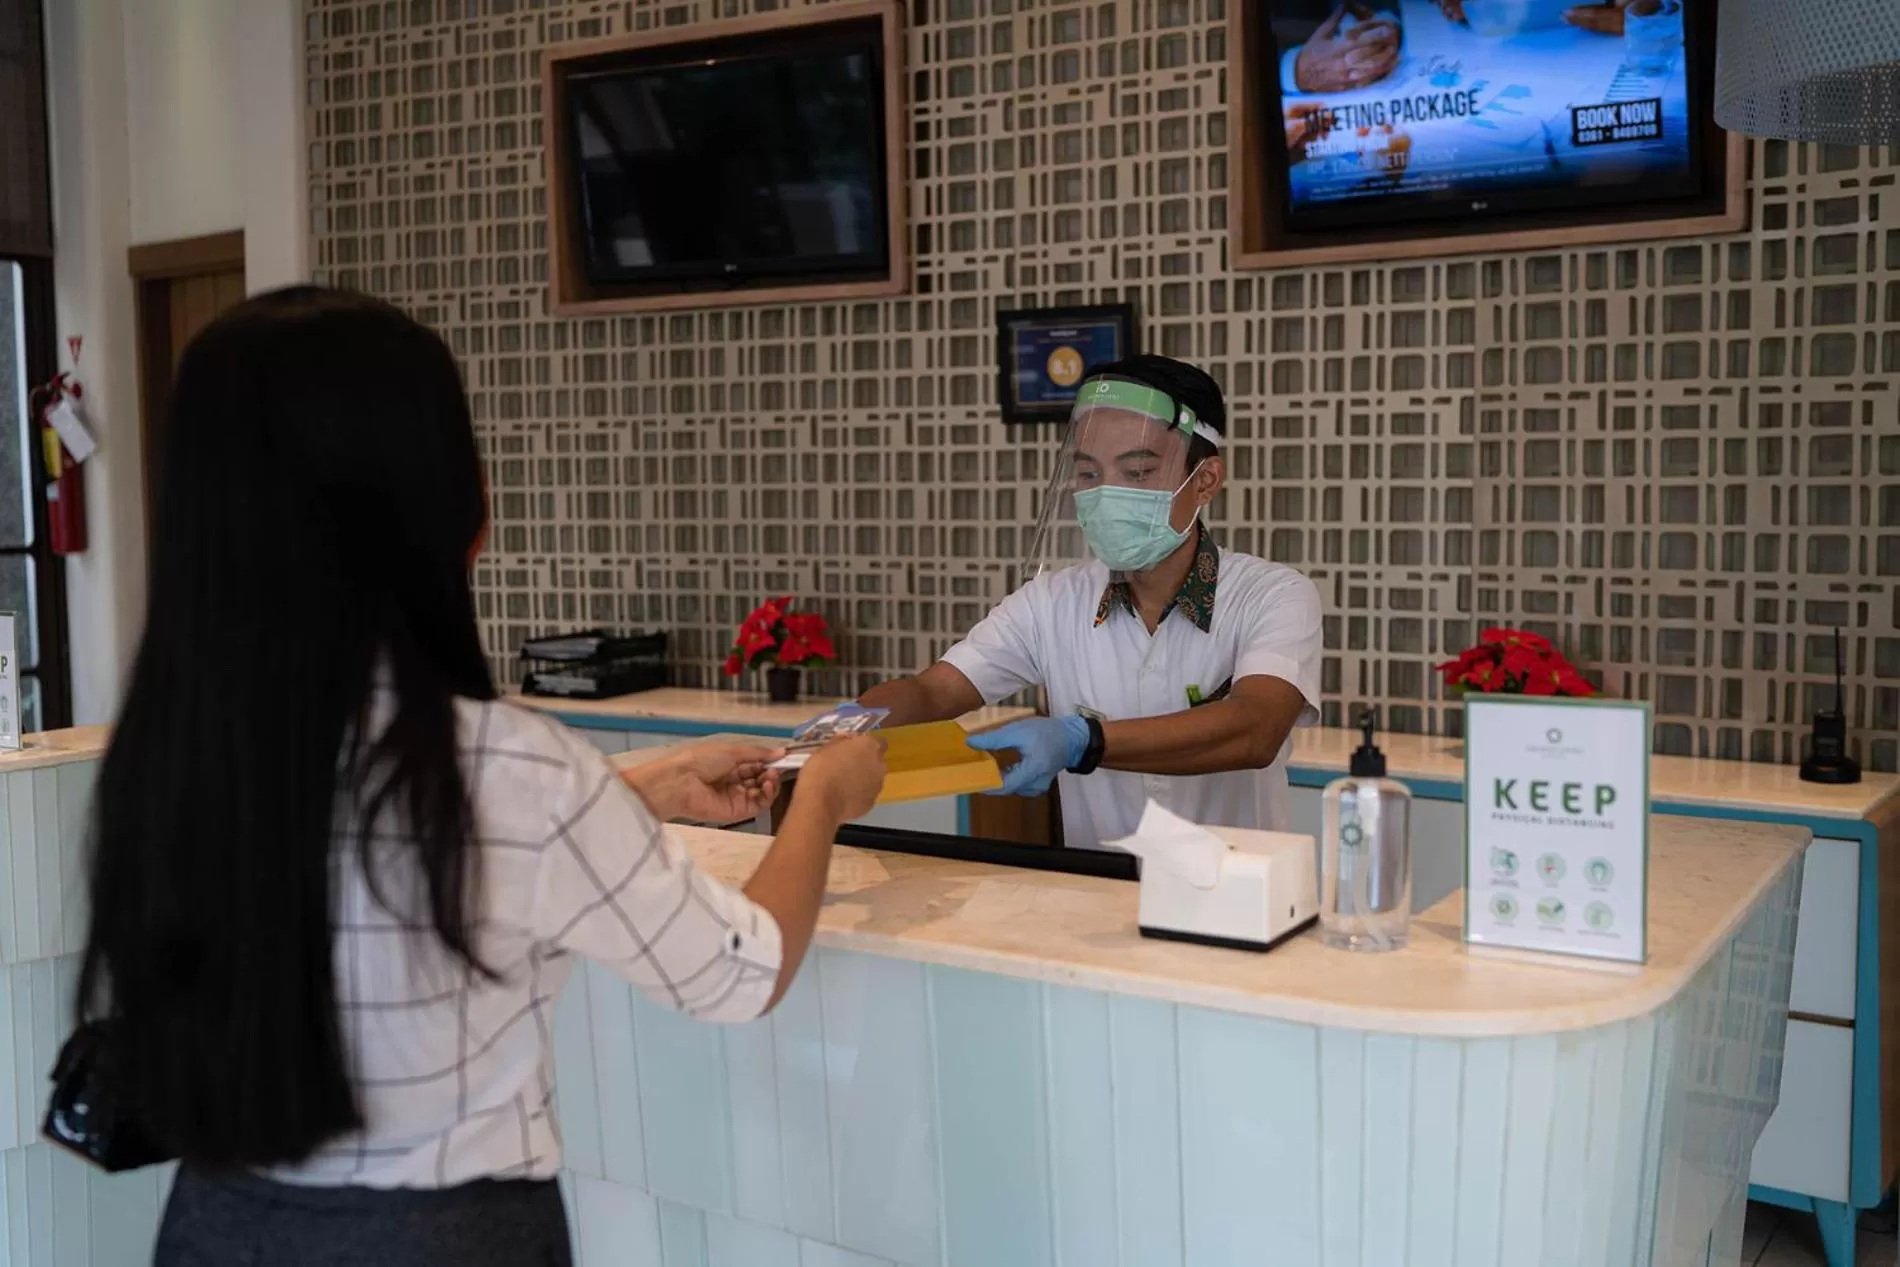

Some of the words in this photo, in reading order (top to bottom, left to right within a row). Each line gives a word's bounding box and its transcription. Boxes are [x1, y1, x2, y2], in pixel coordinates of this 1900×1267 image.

[1304, 102, 1386, 134] MEETING
[1391, 88, 1480, 125] PACKAGE
[1577, 105, 1618, 129] BOOK
[1620, 101, 1657, 124] NOW
[1494, 777, 1617, 816] KEEP
